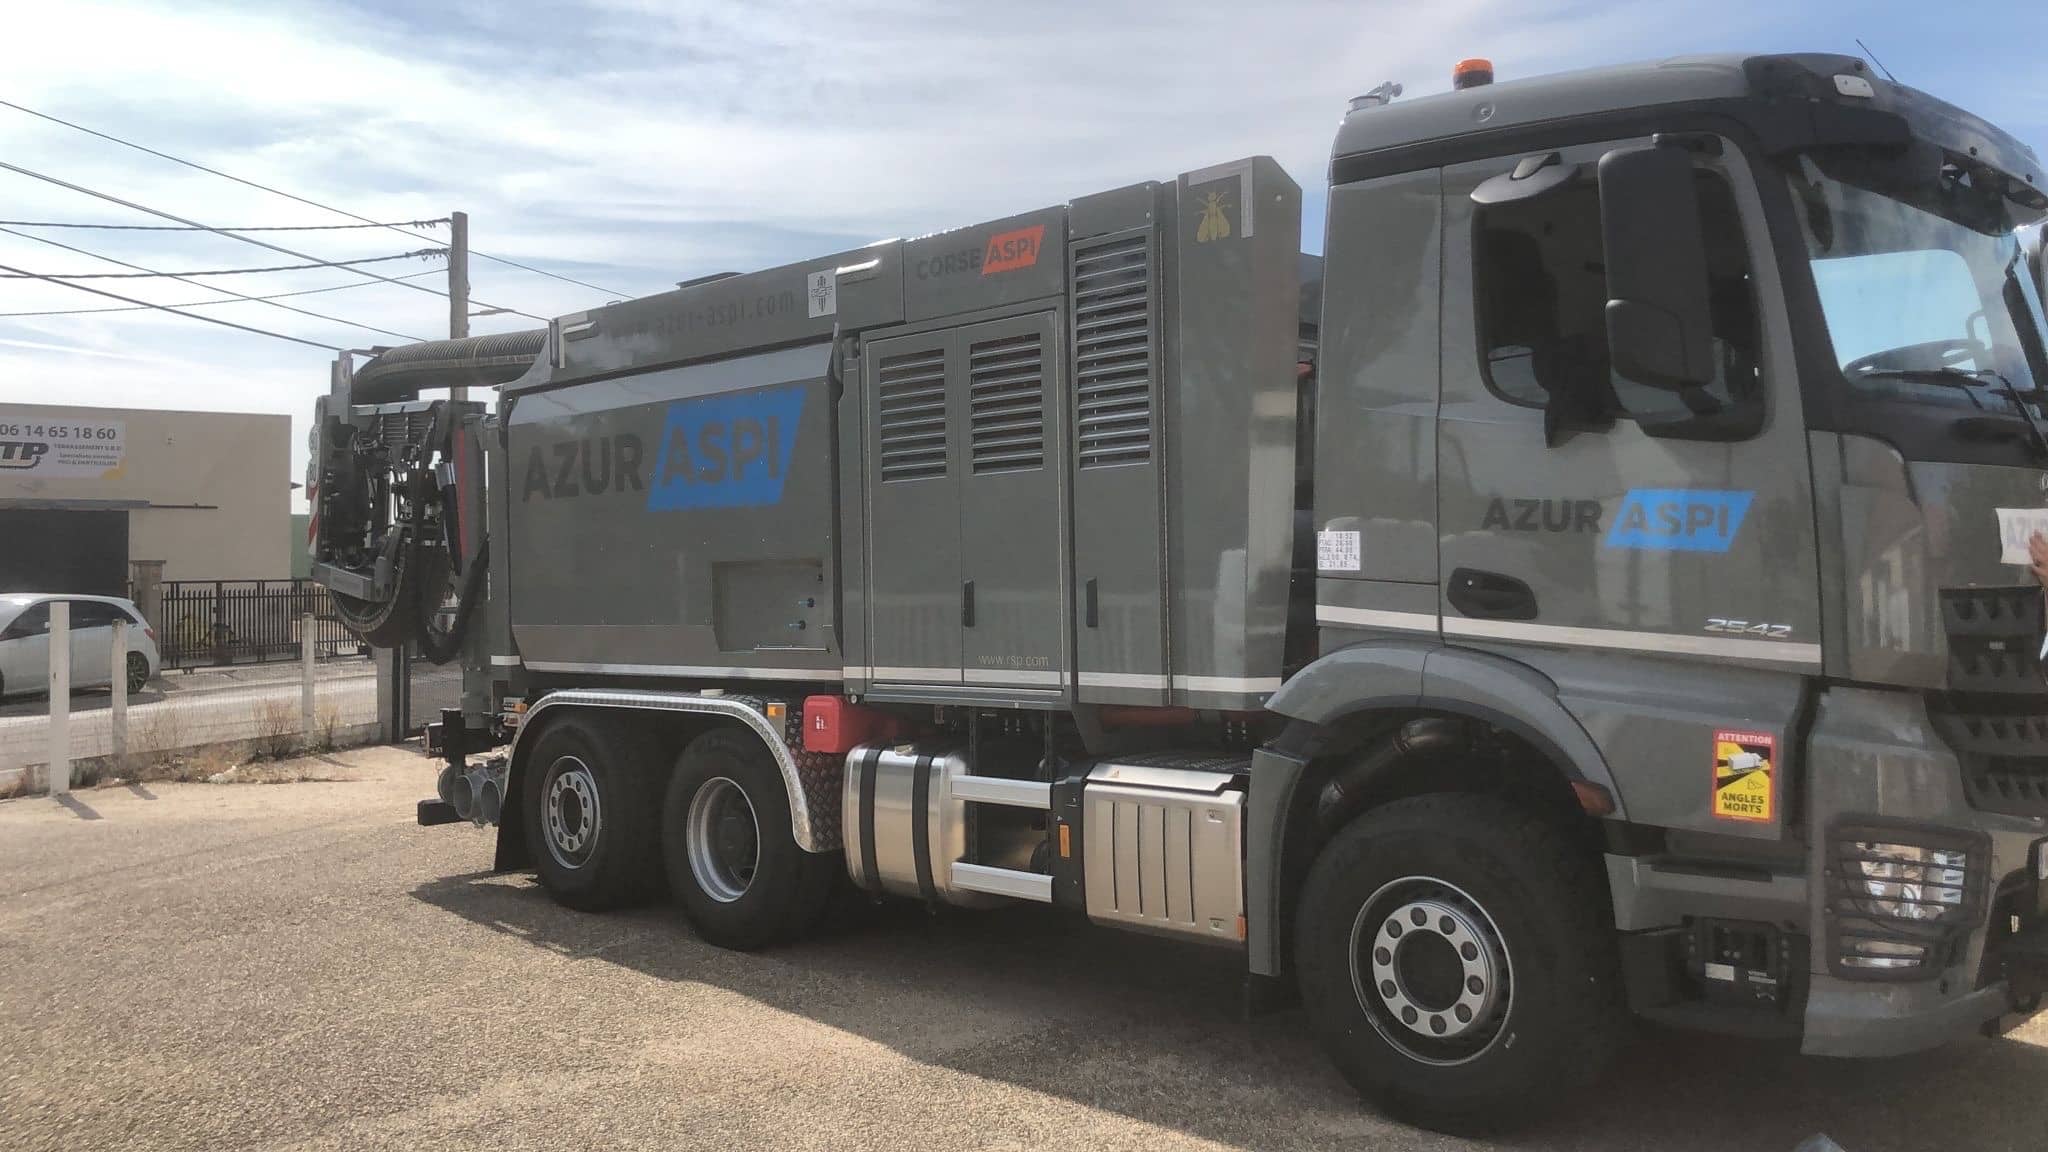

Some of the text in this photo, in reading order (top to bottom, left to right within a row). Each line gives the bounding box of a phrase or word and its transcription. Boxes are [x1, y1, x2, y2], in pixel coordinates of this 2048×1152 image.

[916, 237, 1037, 280] CORSE ASPI
[0, 423, 116, 440] 06 14 65 18 60
[523, 415, 781, 502] AZUR ASPI
[1480, 497, 1729, 538] AZUR ASPI
[1704, 618, 1791, 639] 2542
[976, 655, 1049, 669] www.rsp.com
[1718, 732, 1772, 744] ATTENTION
[1721, 792, 1764, 804] ANGLES
[1723, 803, 1762, 814] MORTS
